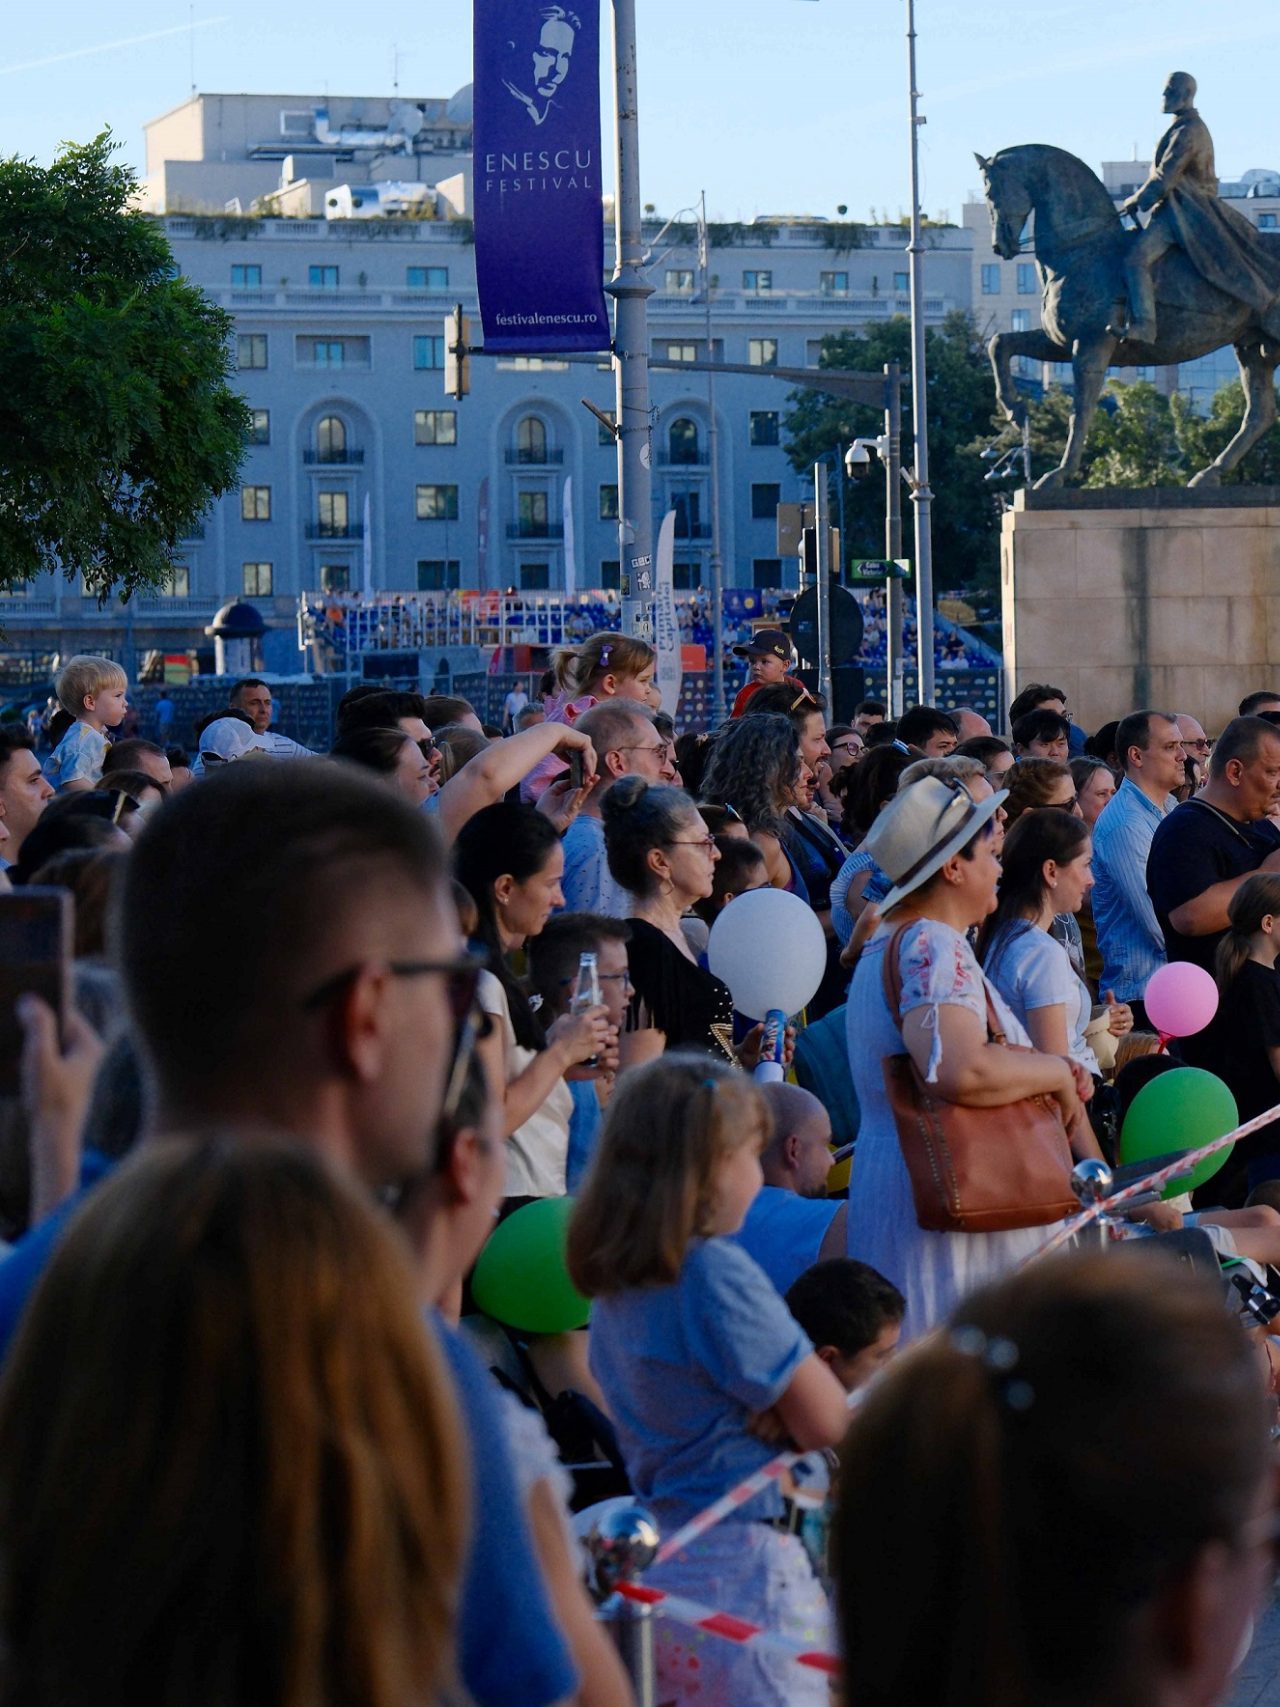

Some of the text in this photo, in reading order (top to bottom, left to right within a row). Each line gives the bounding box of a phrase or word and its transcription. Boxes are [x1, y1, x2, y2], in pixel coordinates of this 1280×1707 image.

[486, 150, 591, 173] ENESCU
[486, 176, 592, 192] FESTIVAL
[495, 312, 598, 326] festivalenescu.ro
